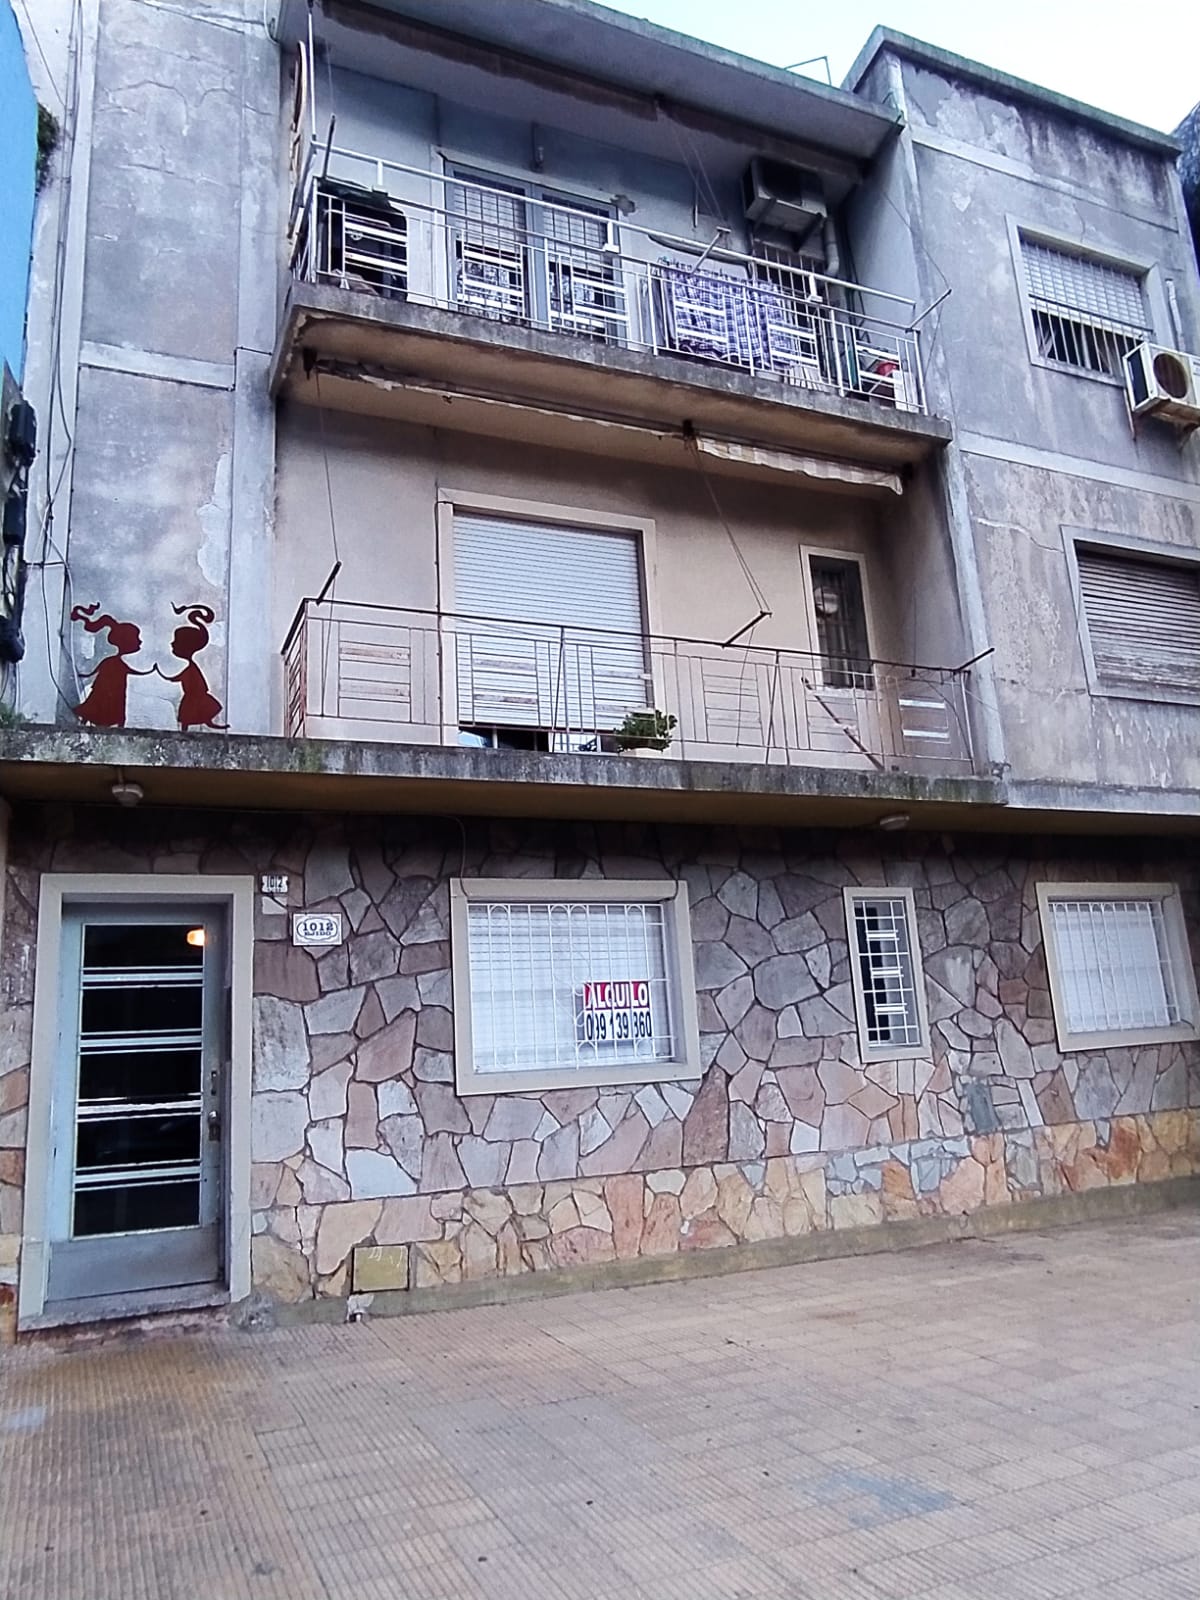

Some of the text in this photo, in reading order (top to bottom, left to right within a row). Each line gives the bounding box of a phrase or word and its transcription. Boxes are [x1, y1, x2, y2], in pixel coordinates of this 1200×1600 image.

[266, 876, 283, 888] 1012
[302, 922, 334, 931] 1012
[586, 983, 648, 1009] ALQUILO
